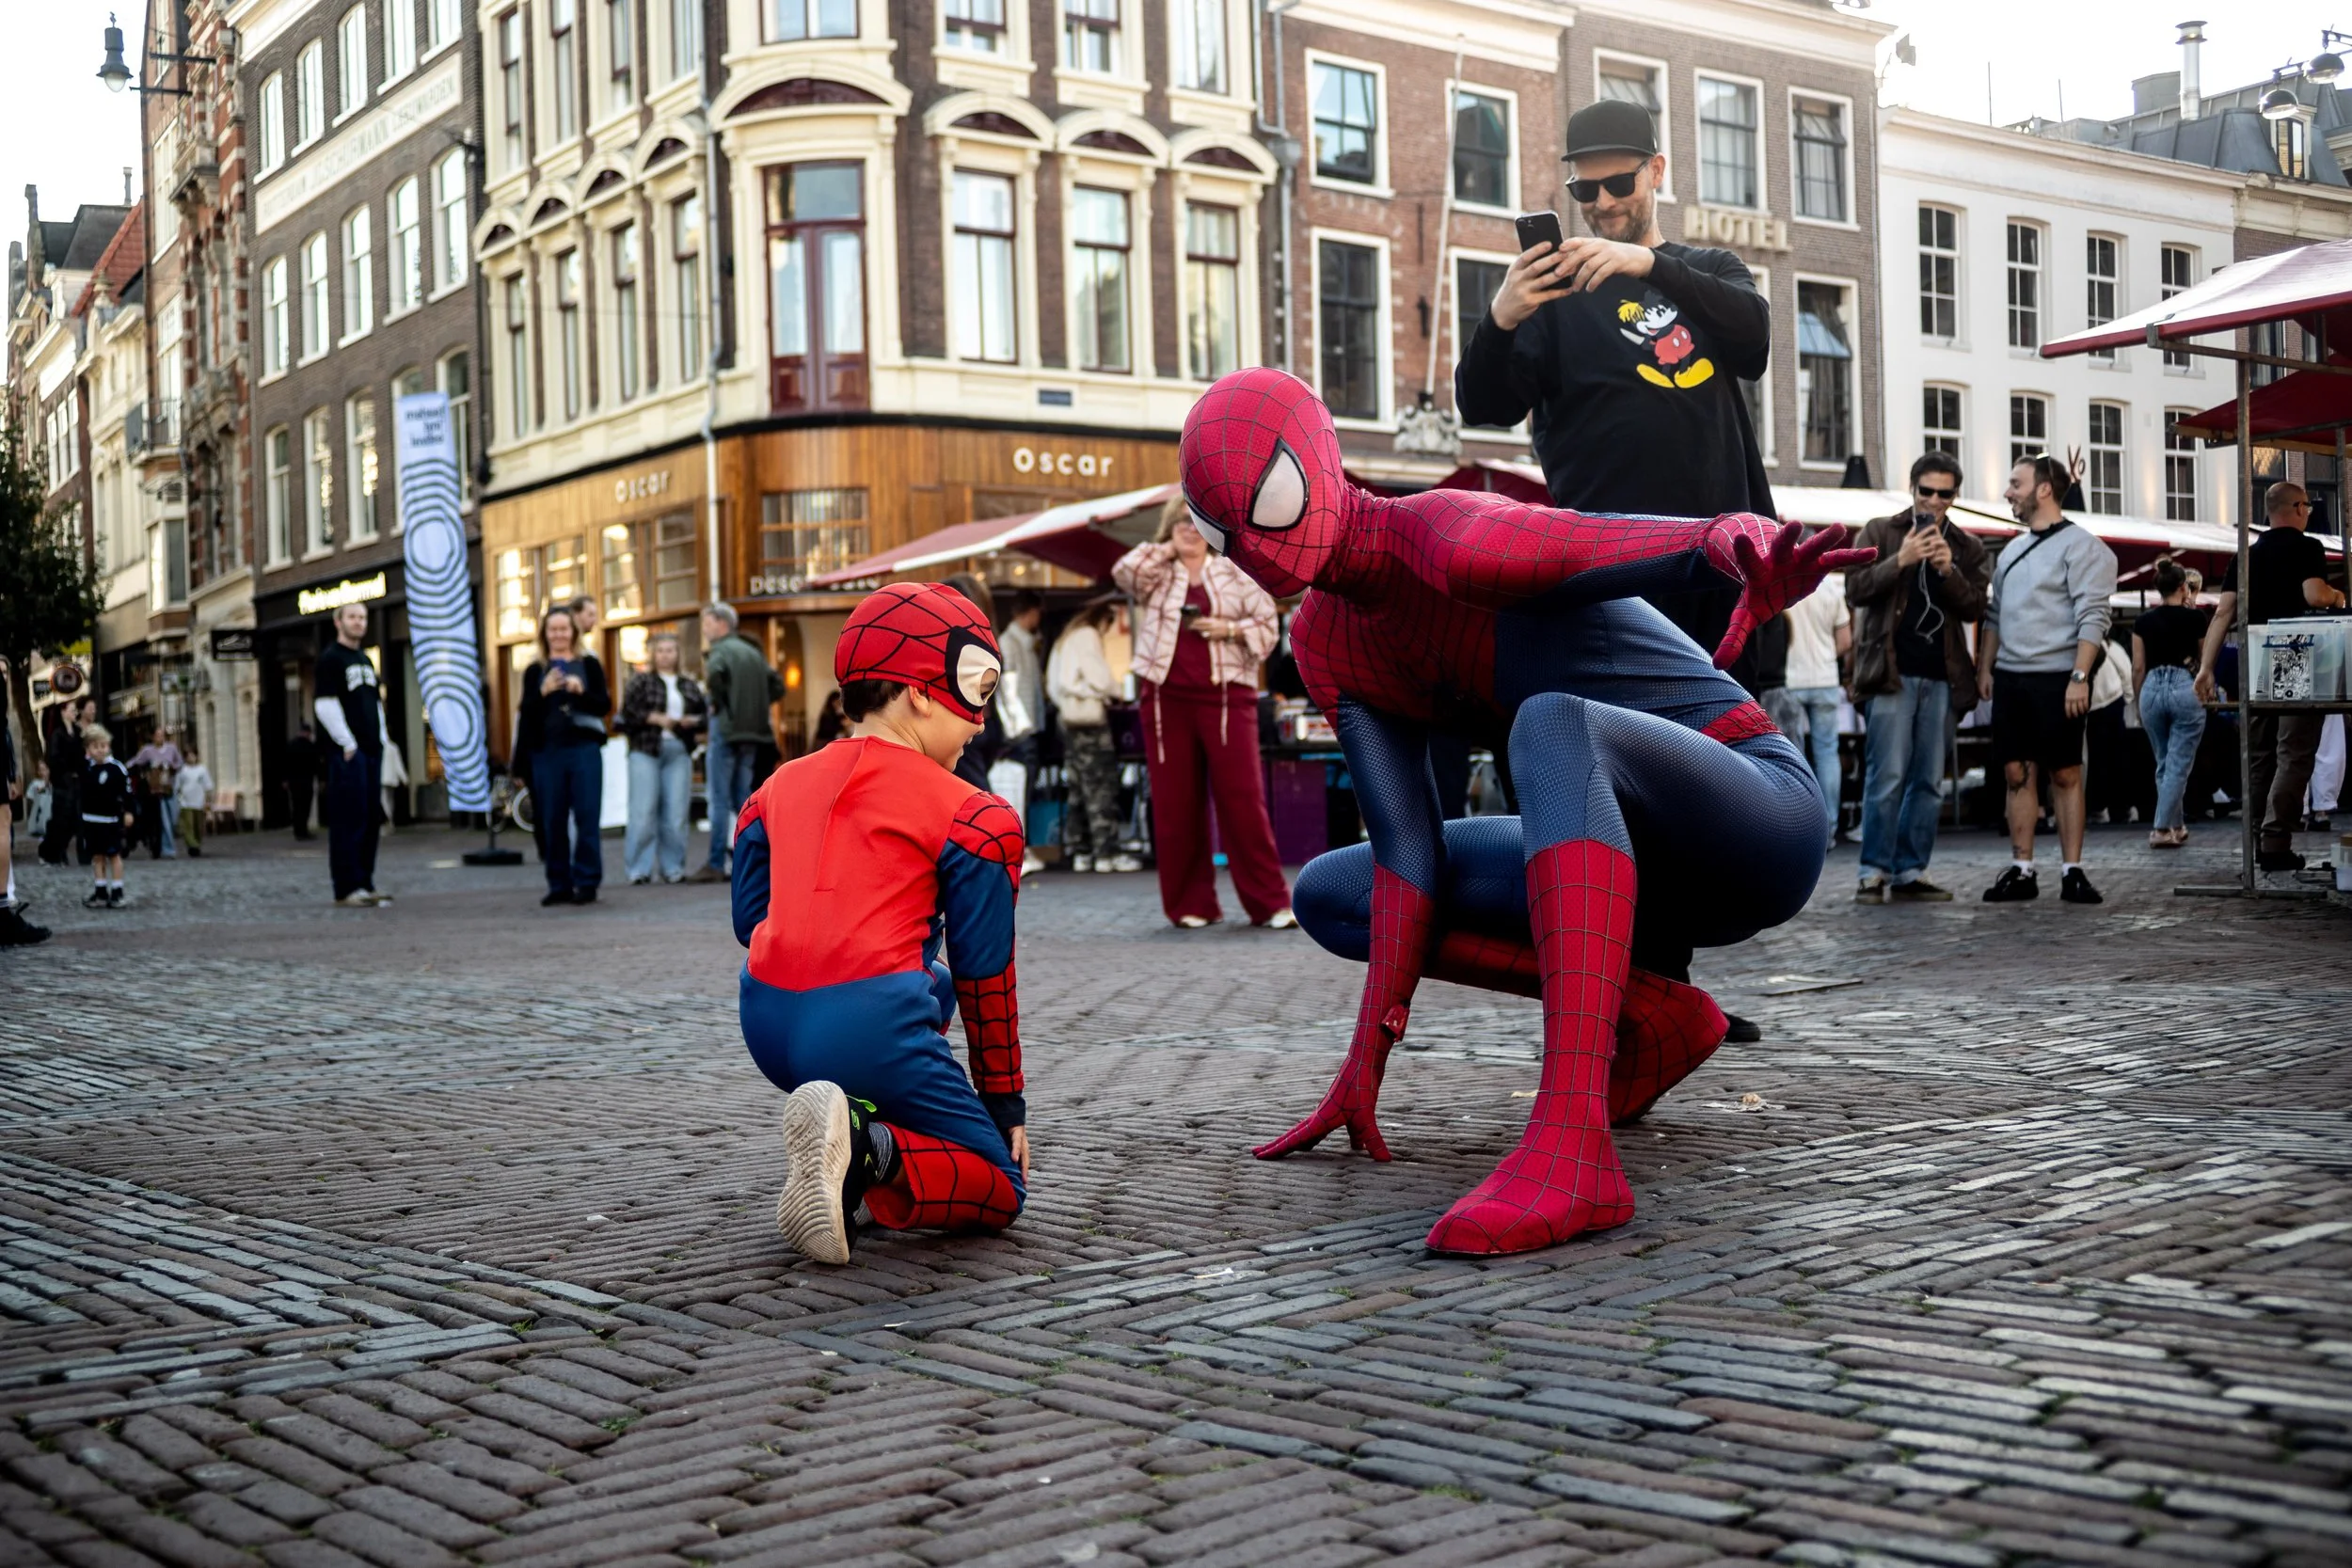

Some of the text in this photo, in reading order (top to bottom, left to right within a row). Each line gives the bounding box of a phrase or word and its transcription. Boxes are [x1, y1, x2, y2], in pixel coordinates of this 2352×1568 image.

[1684, 205, 1793, 252] HOTEL
[1012, 447, 1114, 478] Oscar
[614, 470, 670, 503] Oscar
